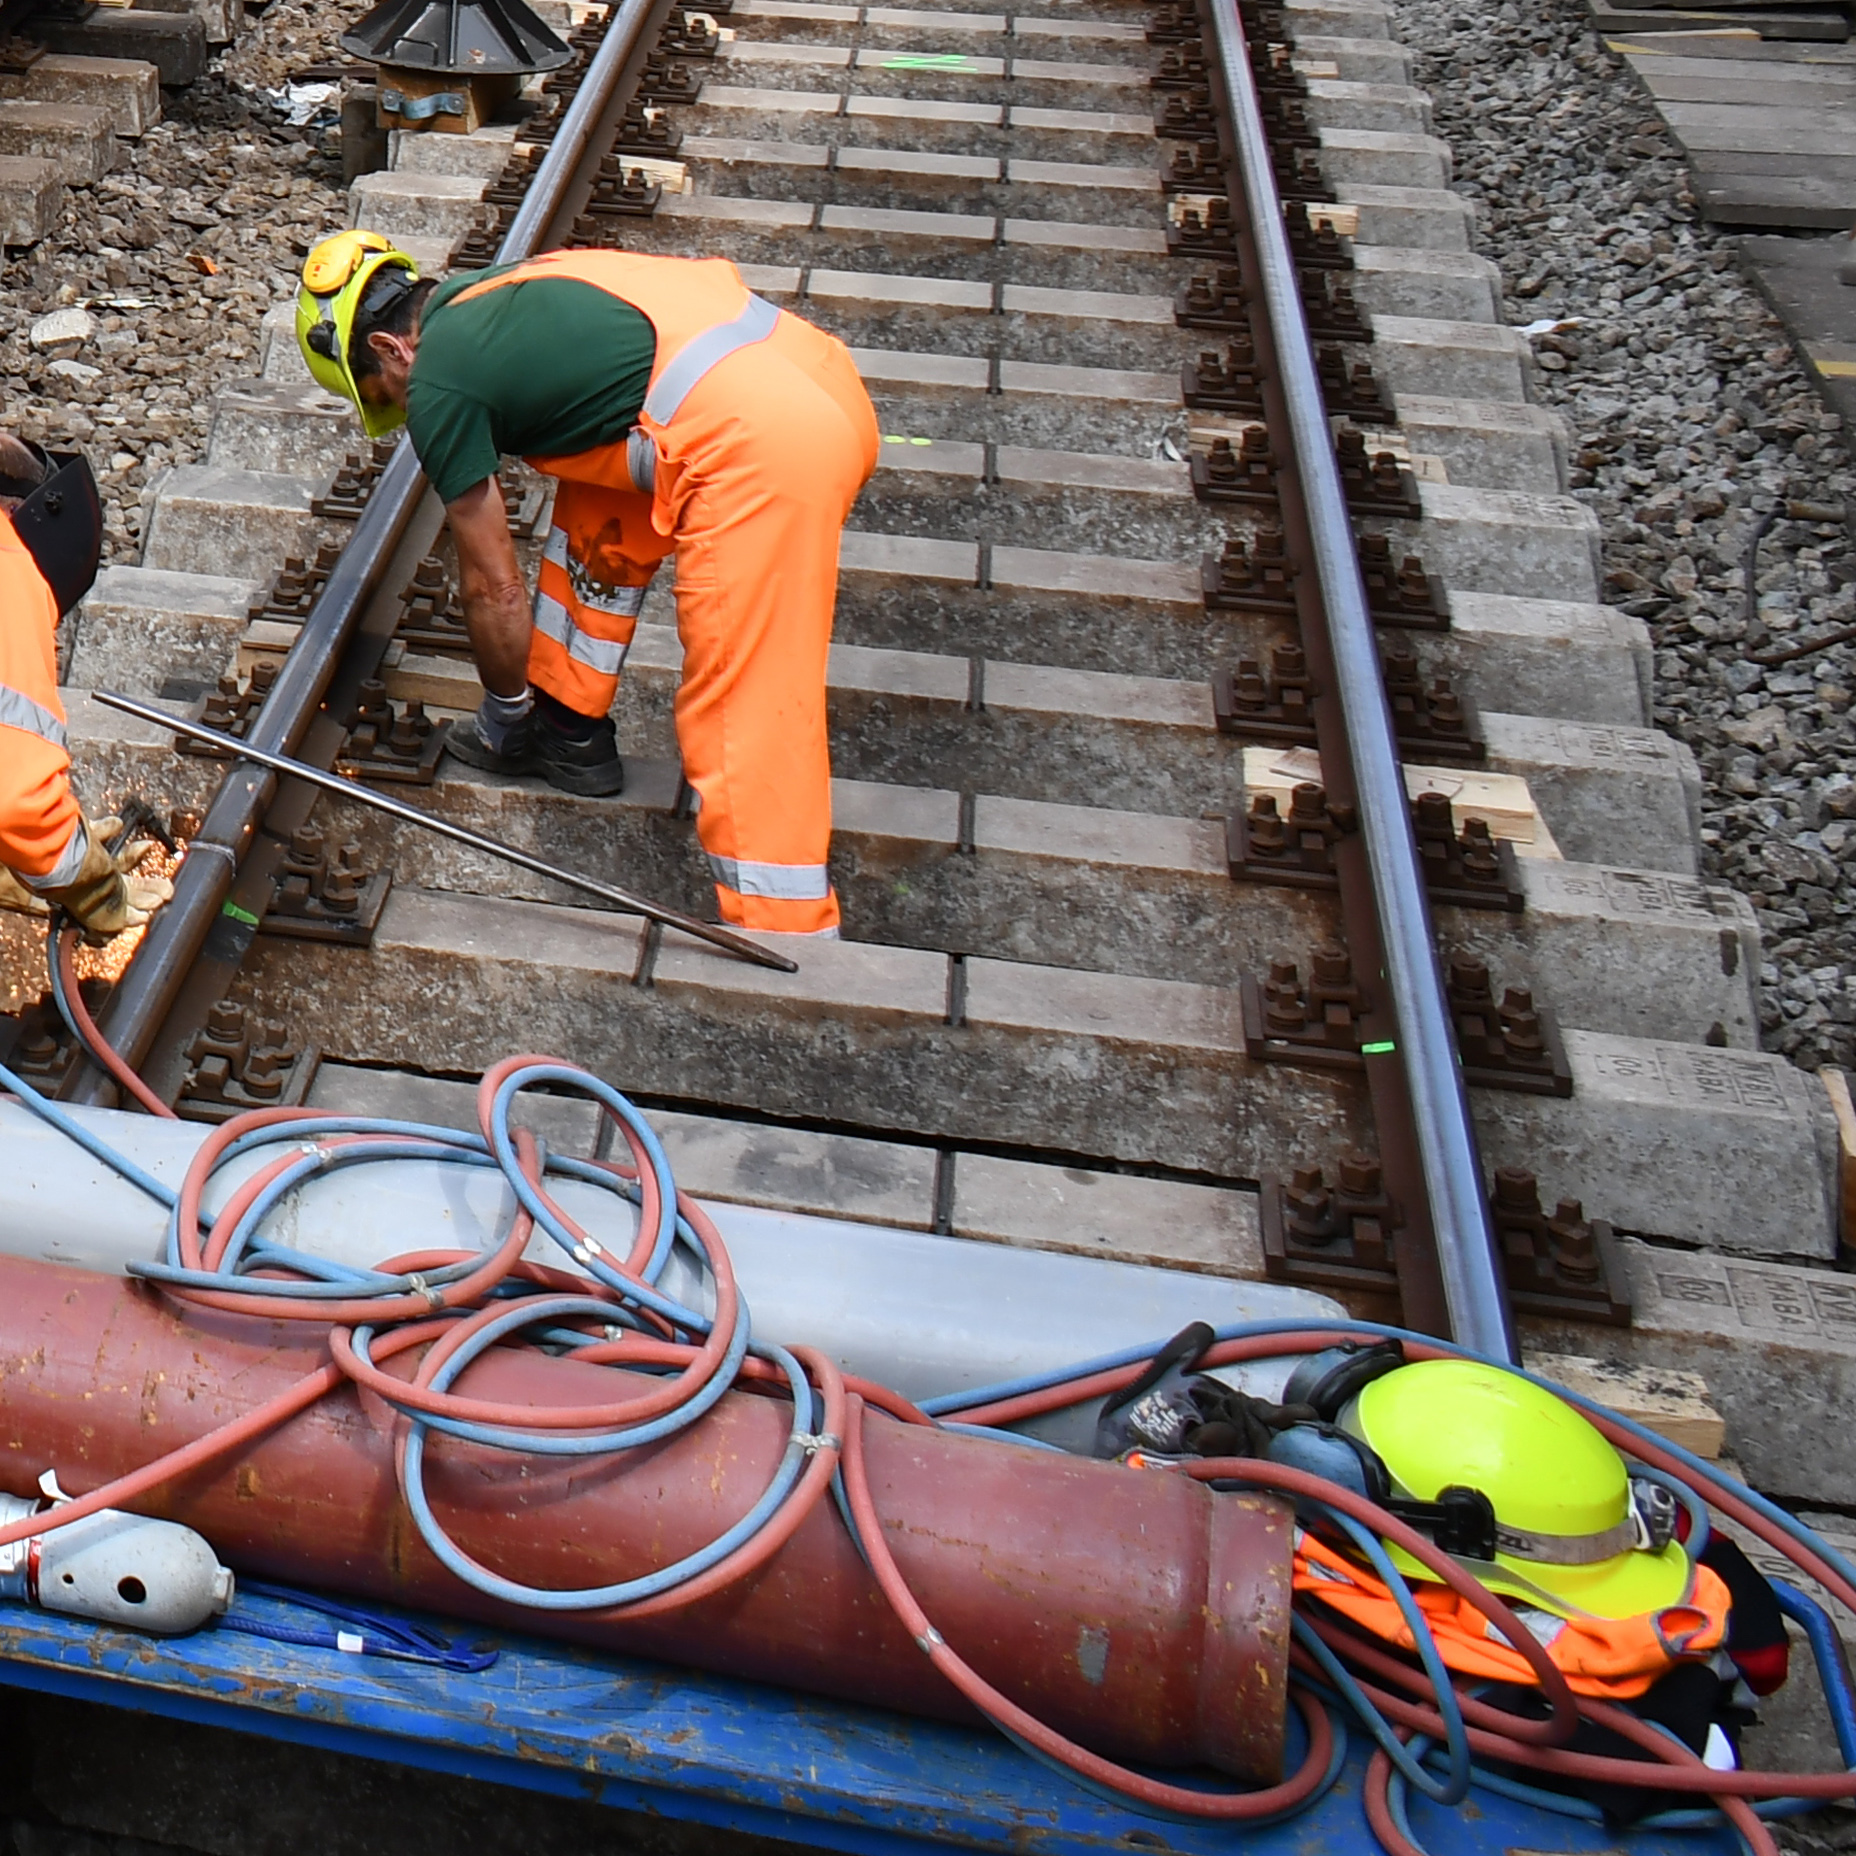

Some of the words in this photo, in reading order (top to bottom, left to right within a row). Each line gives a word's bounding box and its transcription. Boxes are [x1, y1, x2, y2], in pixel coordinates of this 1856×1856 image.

[1690, 1059, 1725, 1095] MABA
[1678, 1278, 1714, 1302] 06
[1763, 1278, 1806, 1325] MABA
